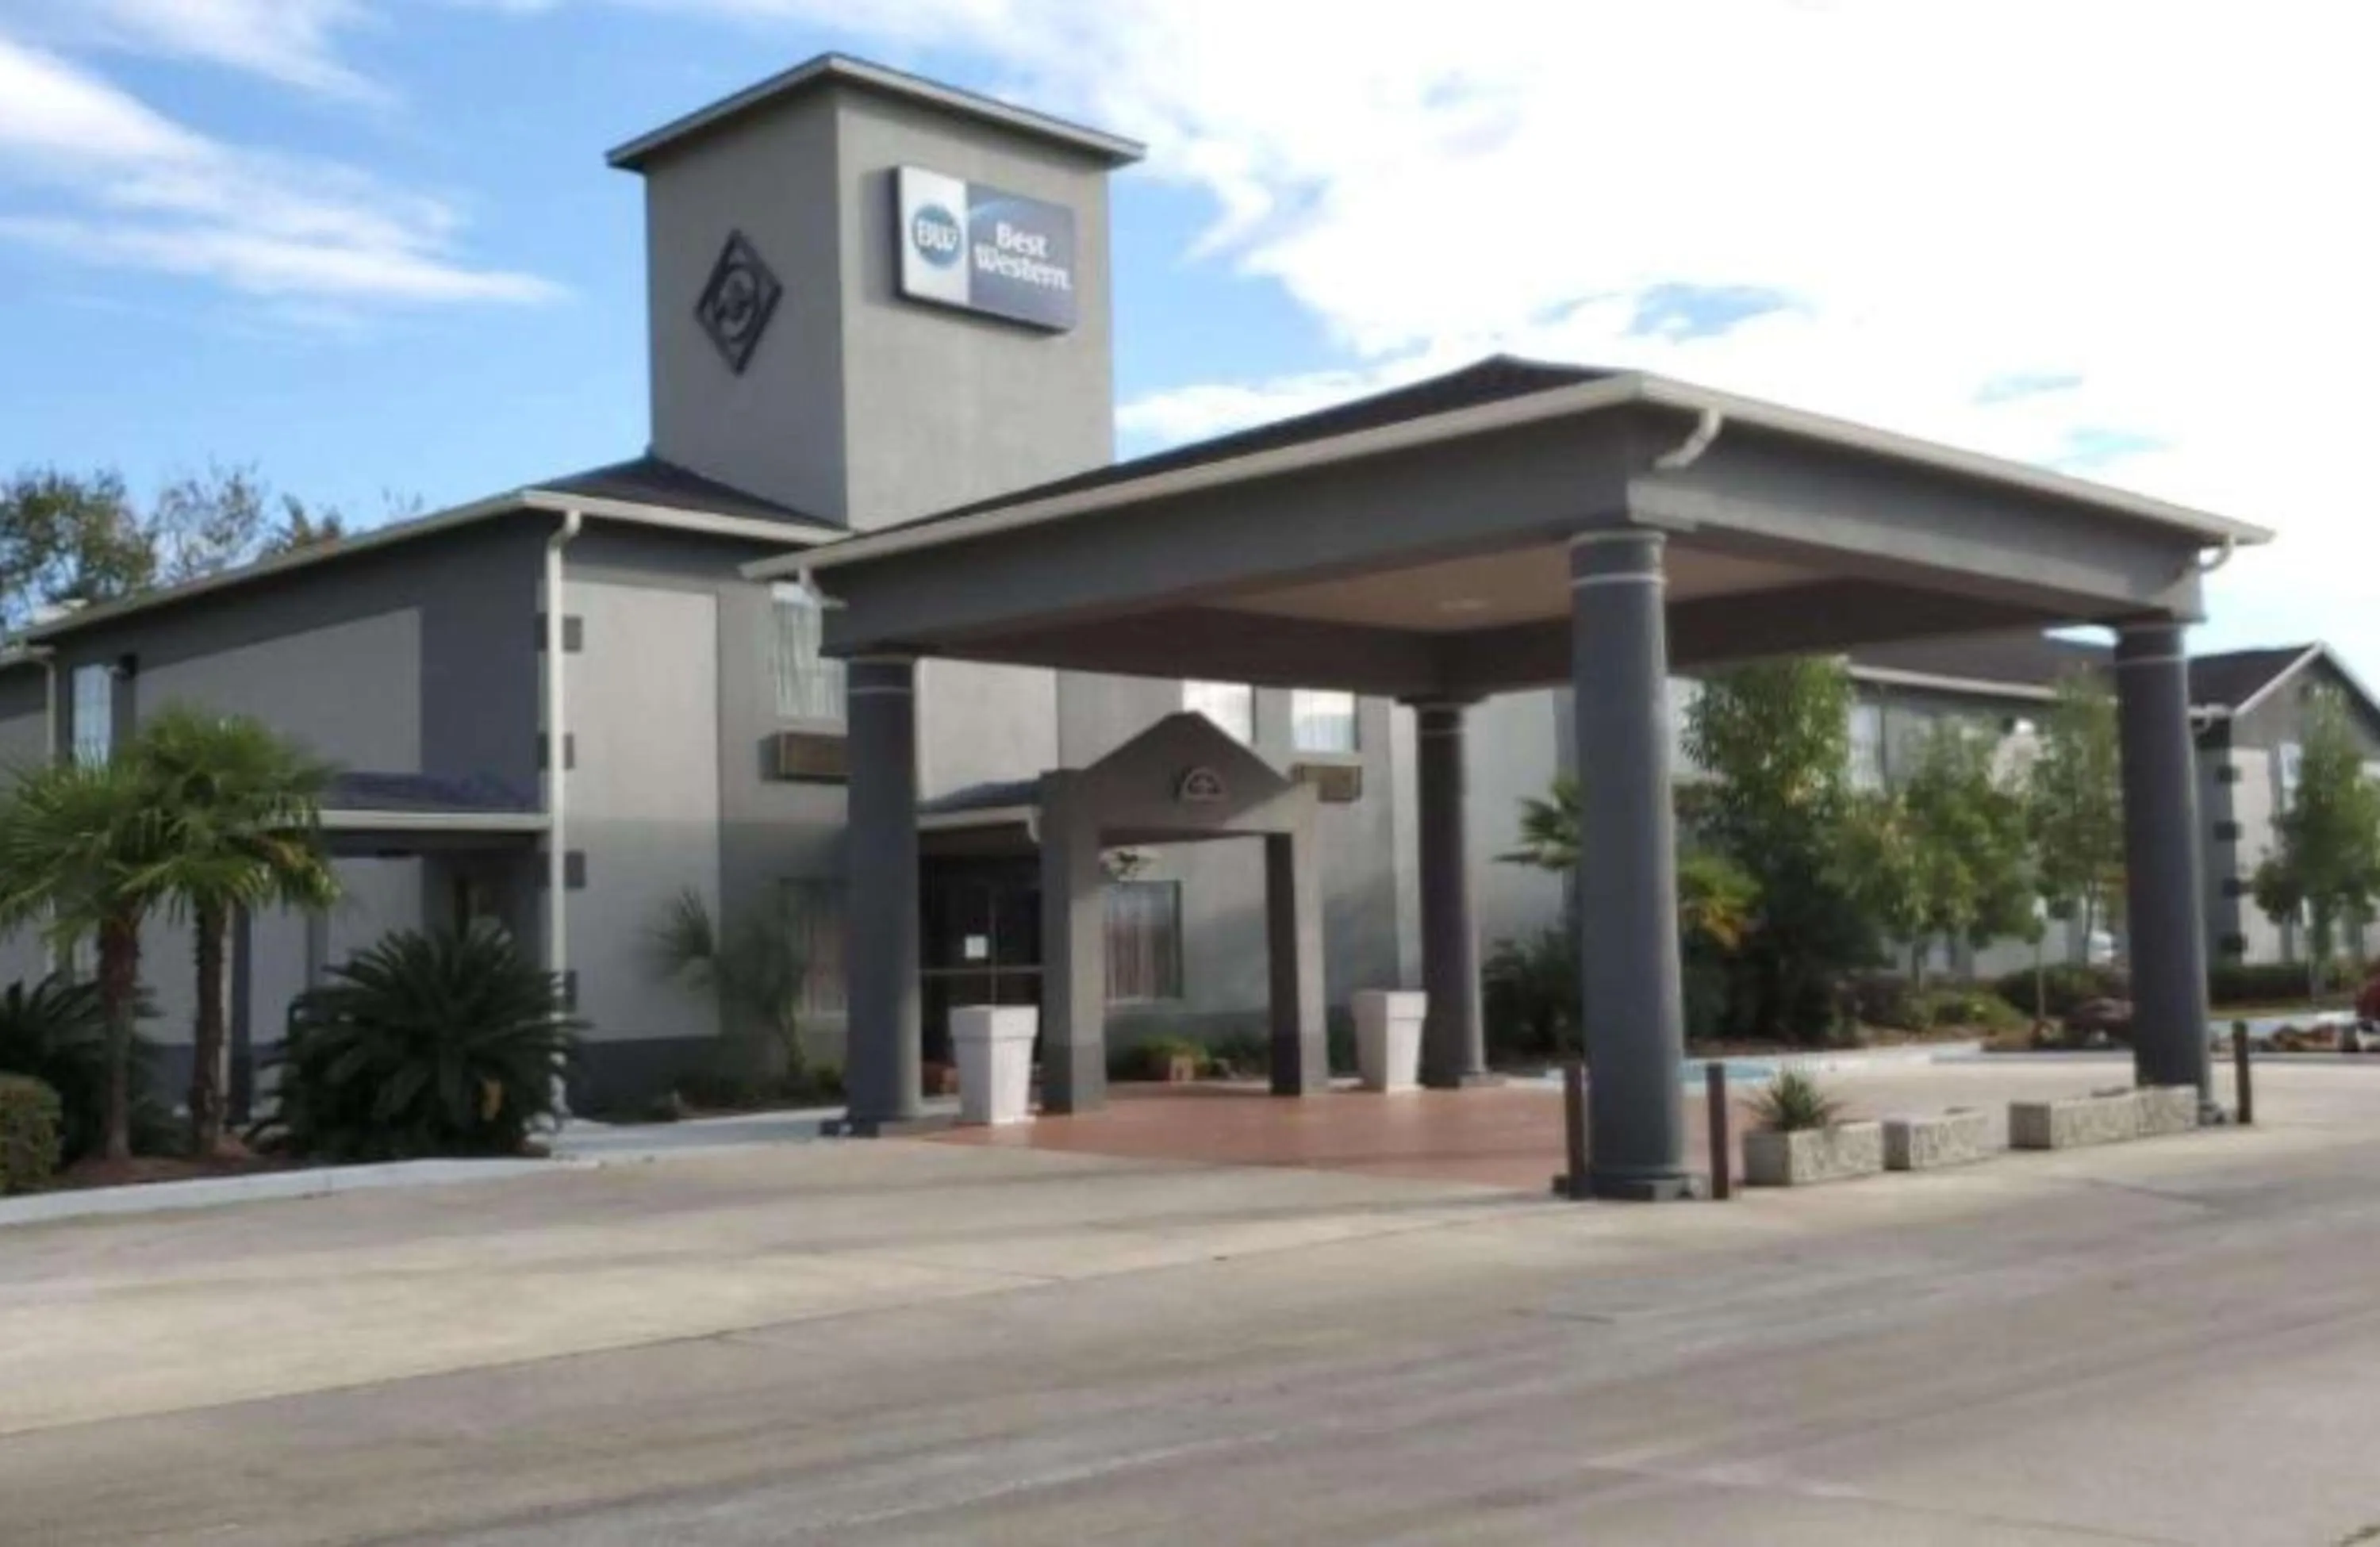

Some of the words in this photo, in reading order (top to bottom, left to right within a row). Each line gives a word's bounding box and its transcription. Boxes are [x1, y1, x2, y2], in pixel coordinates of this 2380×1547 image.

[917, 217, 958, 251] BW
[996, 221, 1046, 258] Best
[974, 243, 1071, 290] Western
